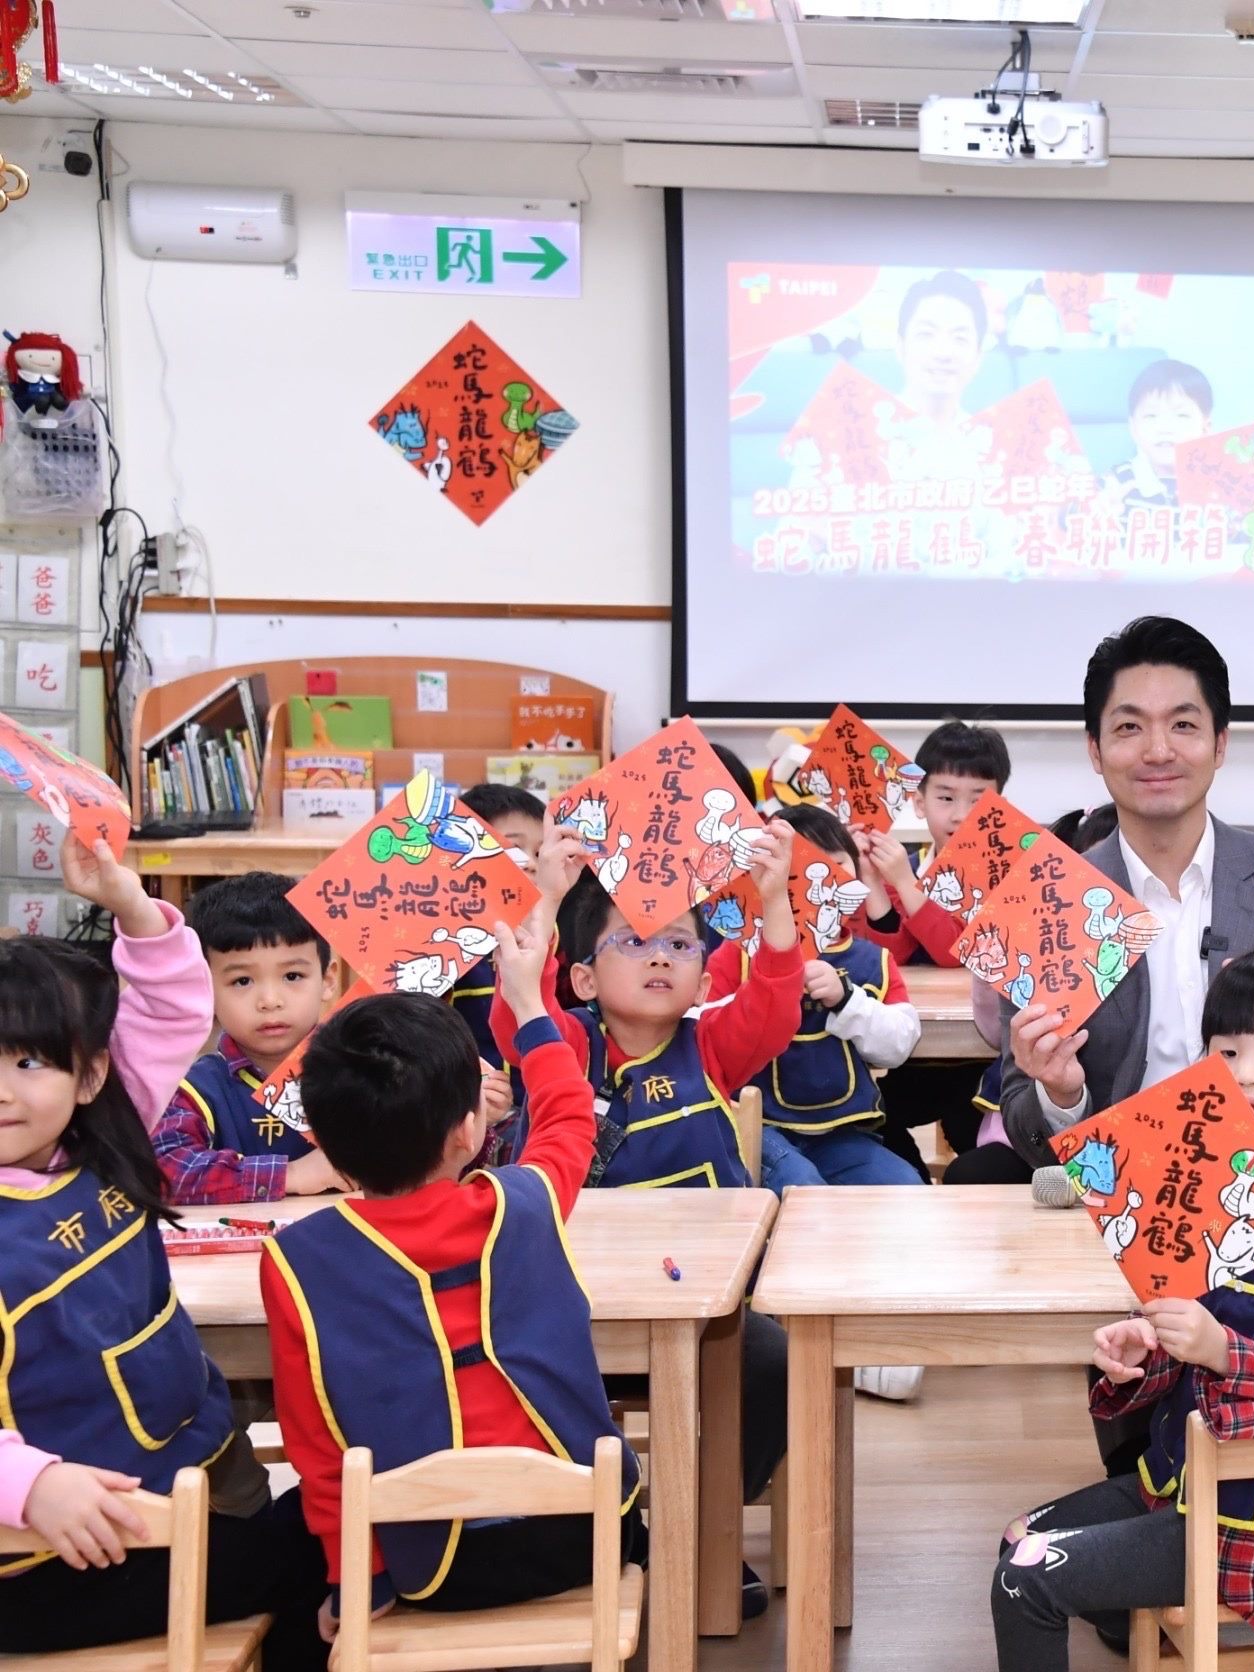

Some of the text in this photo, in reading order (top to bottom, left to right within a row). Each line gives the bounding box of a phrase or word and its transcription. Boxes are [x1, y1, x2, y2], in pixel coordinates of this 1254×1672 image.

[366, 252, 428, 268] 緊急出口
[373, 270, 424, 281] EXIT
[779, 279, 838, 297] TAIPEI
[453, 344, 497, 478] 蛇馬龍鶴
[753, 506, 1226, 576] 蛇馬龍鶴 春聯開箱
[31, 566, 57, 615] 爸爸
[27, 663, 57, 692] 吃
[622, 769, 647, 782] 2025
[835, 720, 880, 815] 蛇馬龍鶴
[633, 740, 697, 887] 蛇馬龍鶴
[30, 822, 54, 871] 灰色
[957, 841, 977, 850] 2025
[316, 871, 486, 922] 蛇馬龍鶴
[1003, 894, 1027, 905] 2025
[359, 926, 370, 953] 2025
[1029, 853, 1083, 993] 蛇馬龍鶴
[1134, 1112, 1164, 1130] 2025
[1142, 1084, 1226, 1263] 蛇馬龍鶴
[48, 1184, 136, 1254] 市府
